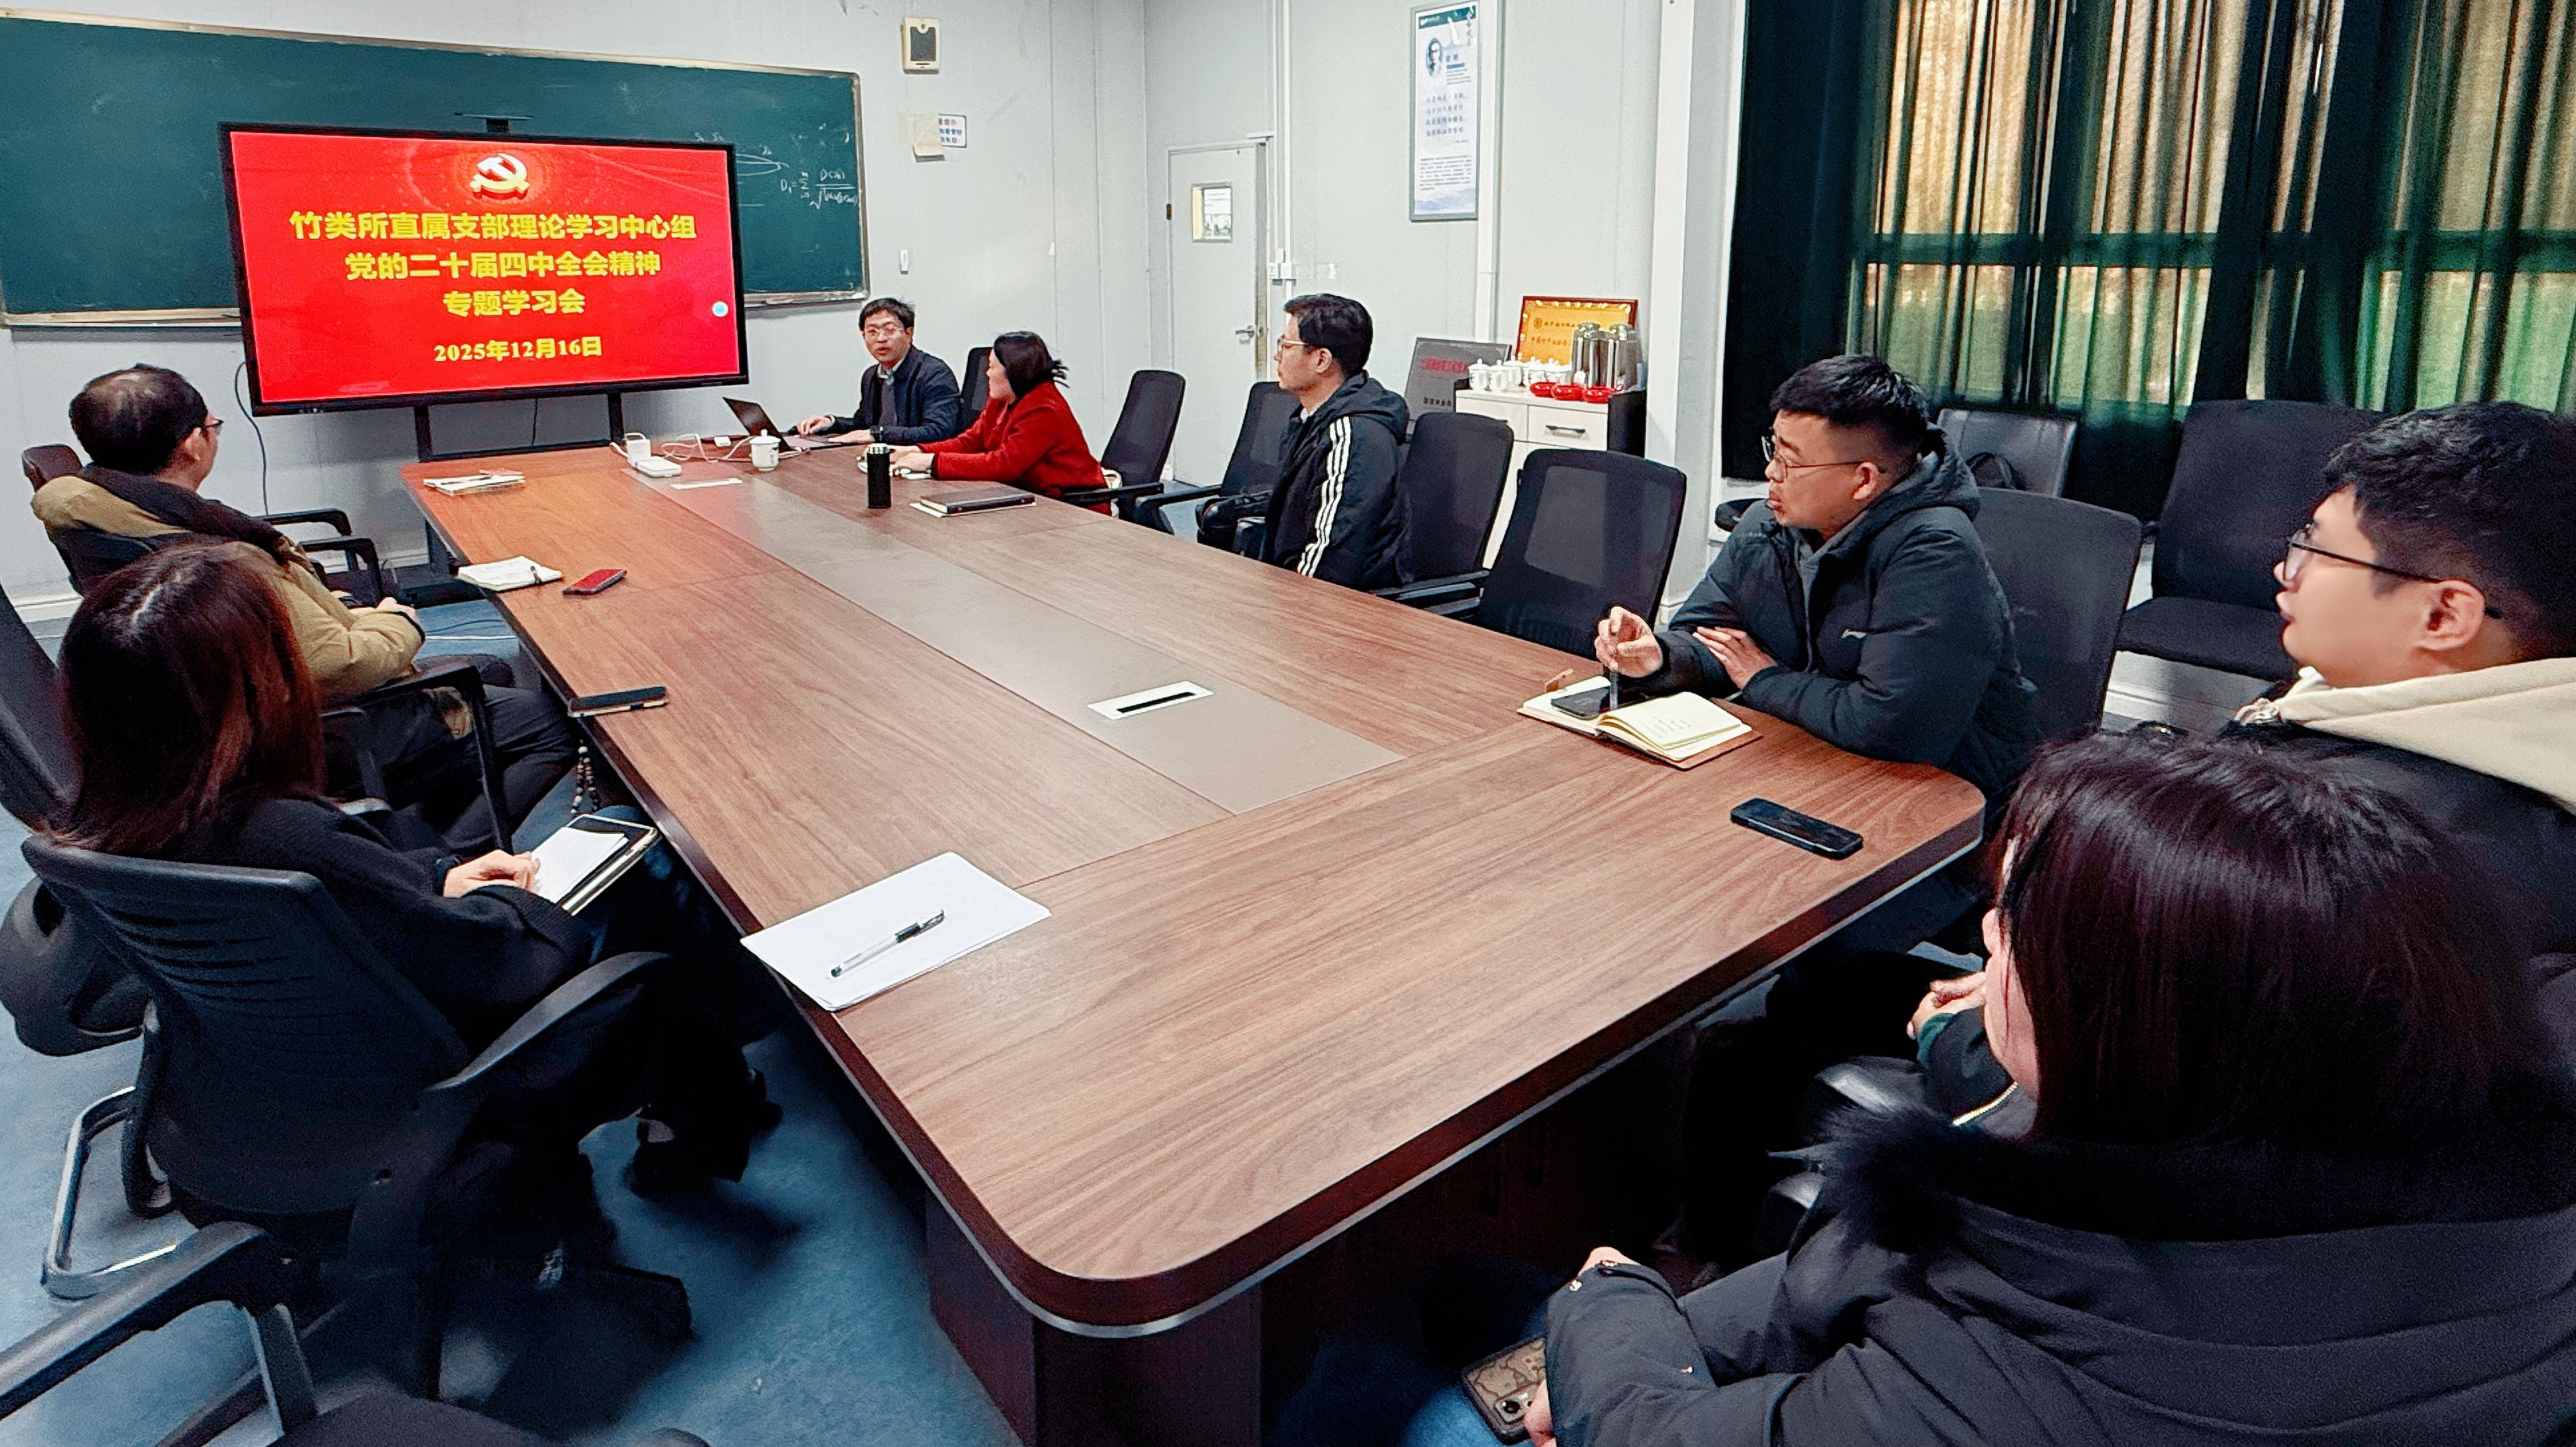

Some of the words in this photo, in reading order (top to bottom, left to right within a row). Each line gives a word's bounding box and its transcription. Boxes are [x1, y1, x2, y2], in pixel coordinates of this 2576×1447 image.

[289, 211, 697, 240] 竹类所直属支部理论学习中心组
[344, 250, 661, 281] 党的二十届四中全会精神
[442, 288, 586, 318] 专题学习会
[433, 336, 602, 362] 2025年12月16日
